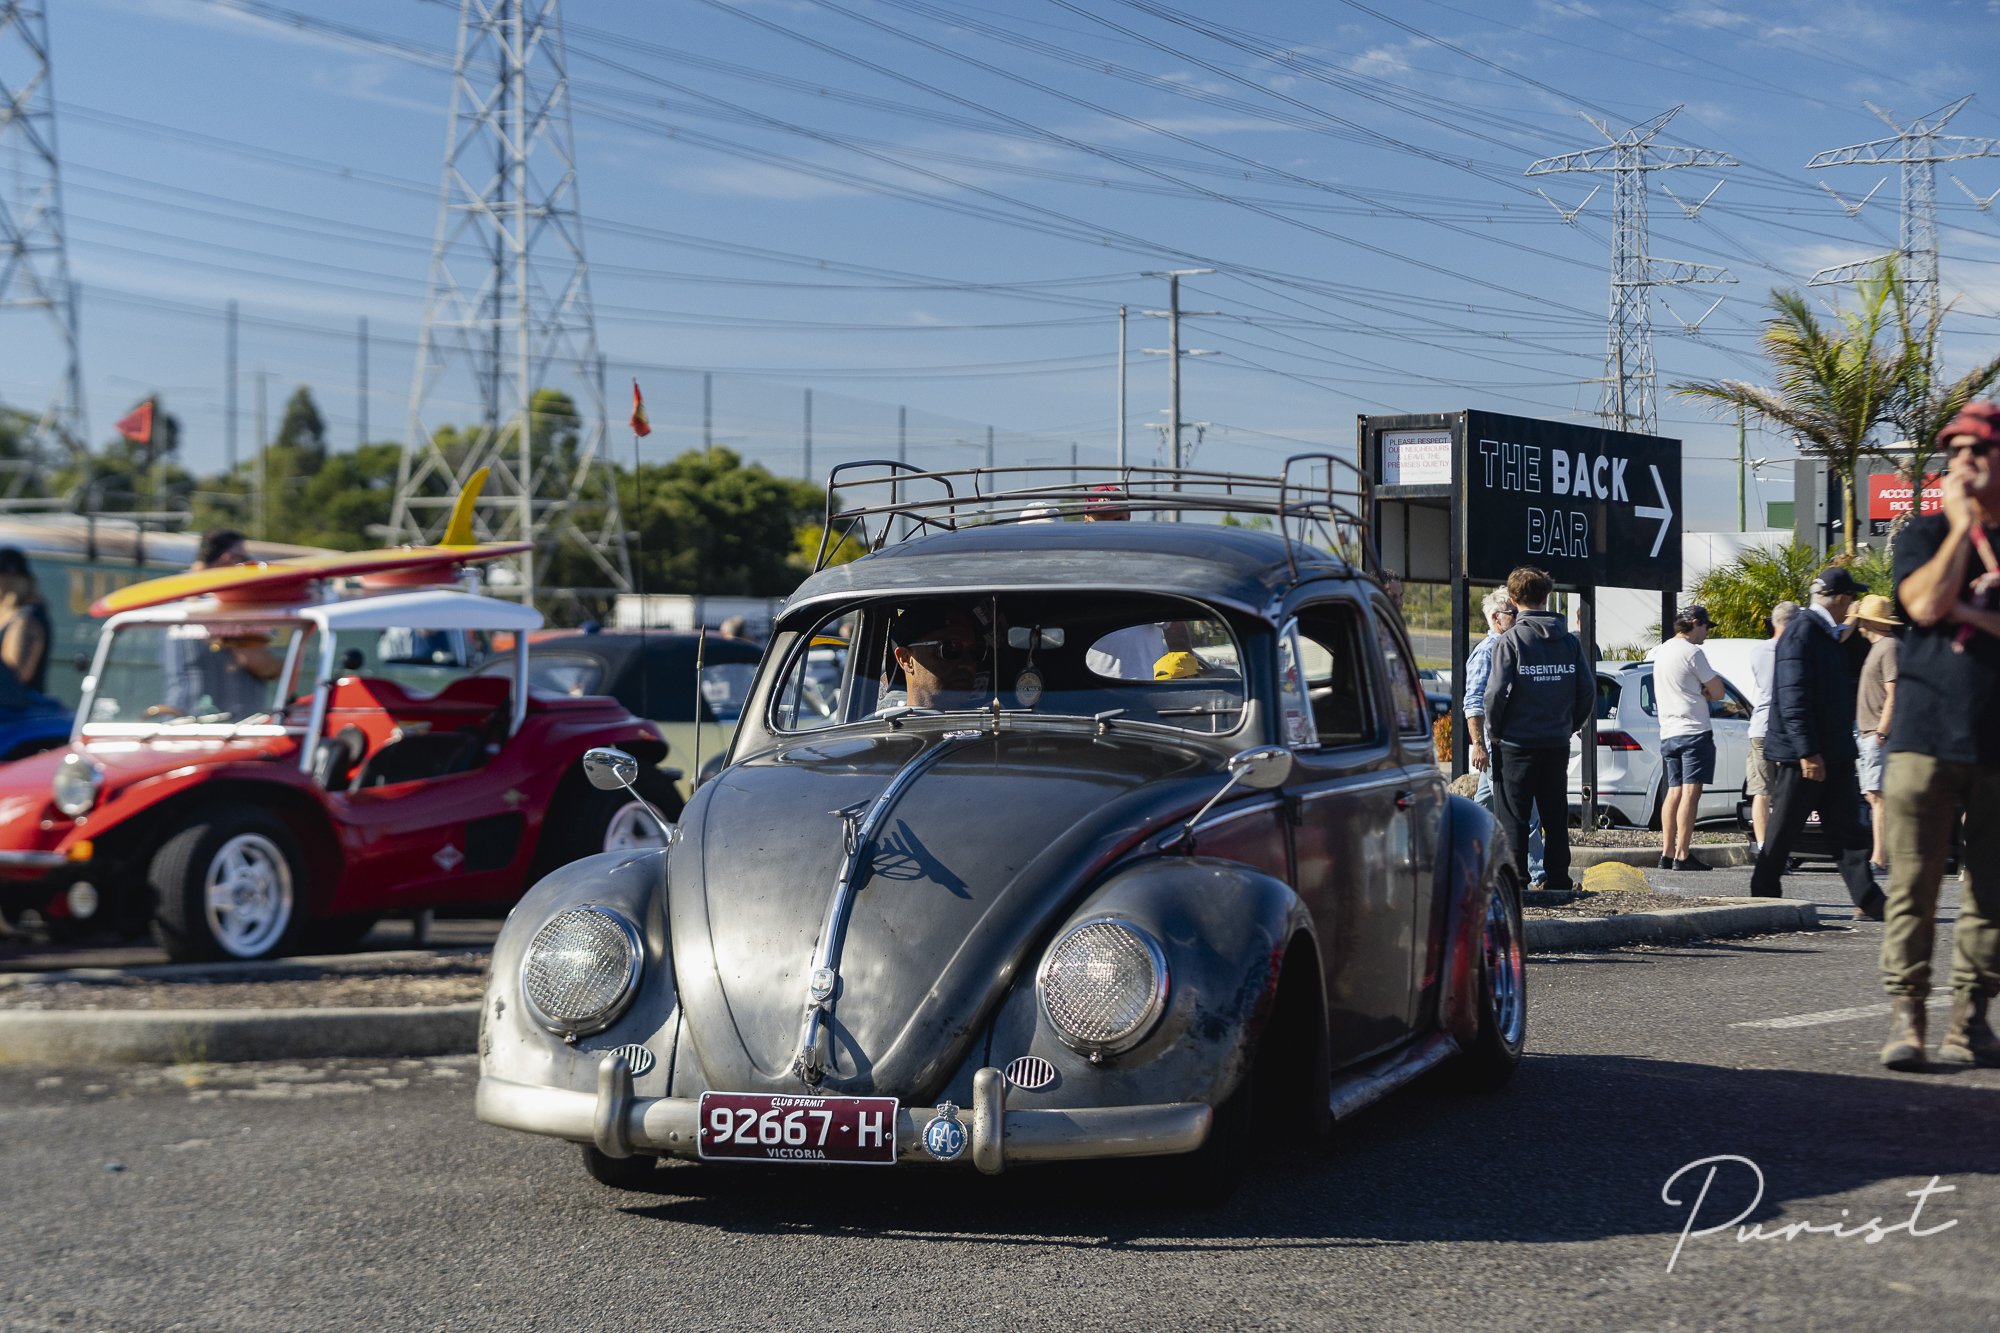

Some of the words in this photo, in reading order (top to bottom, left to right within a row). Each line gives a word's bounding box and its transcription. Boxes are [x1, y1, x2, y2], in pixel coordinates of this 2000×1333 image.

[1389, 438, 1416, 446] PLEASE
[1479, 439, 1542, 494] THE
[1552, 449, 1630, 503] BACK
[1889, 501, 1930, 511] ROS
[1527, 507, 1589, 559] BAR
[1519, 664, 1576, 675] ESSENTIALS
[771, 1097, 793, 1107] CLUB
[793, 1098, 826, 1108] PERMIT
[710, 1107, 833, 1146] 92667
[766, 1148, 826, 1159] VICTORIA
